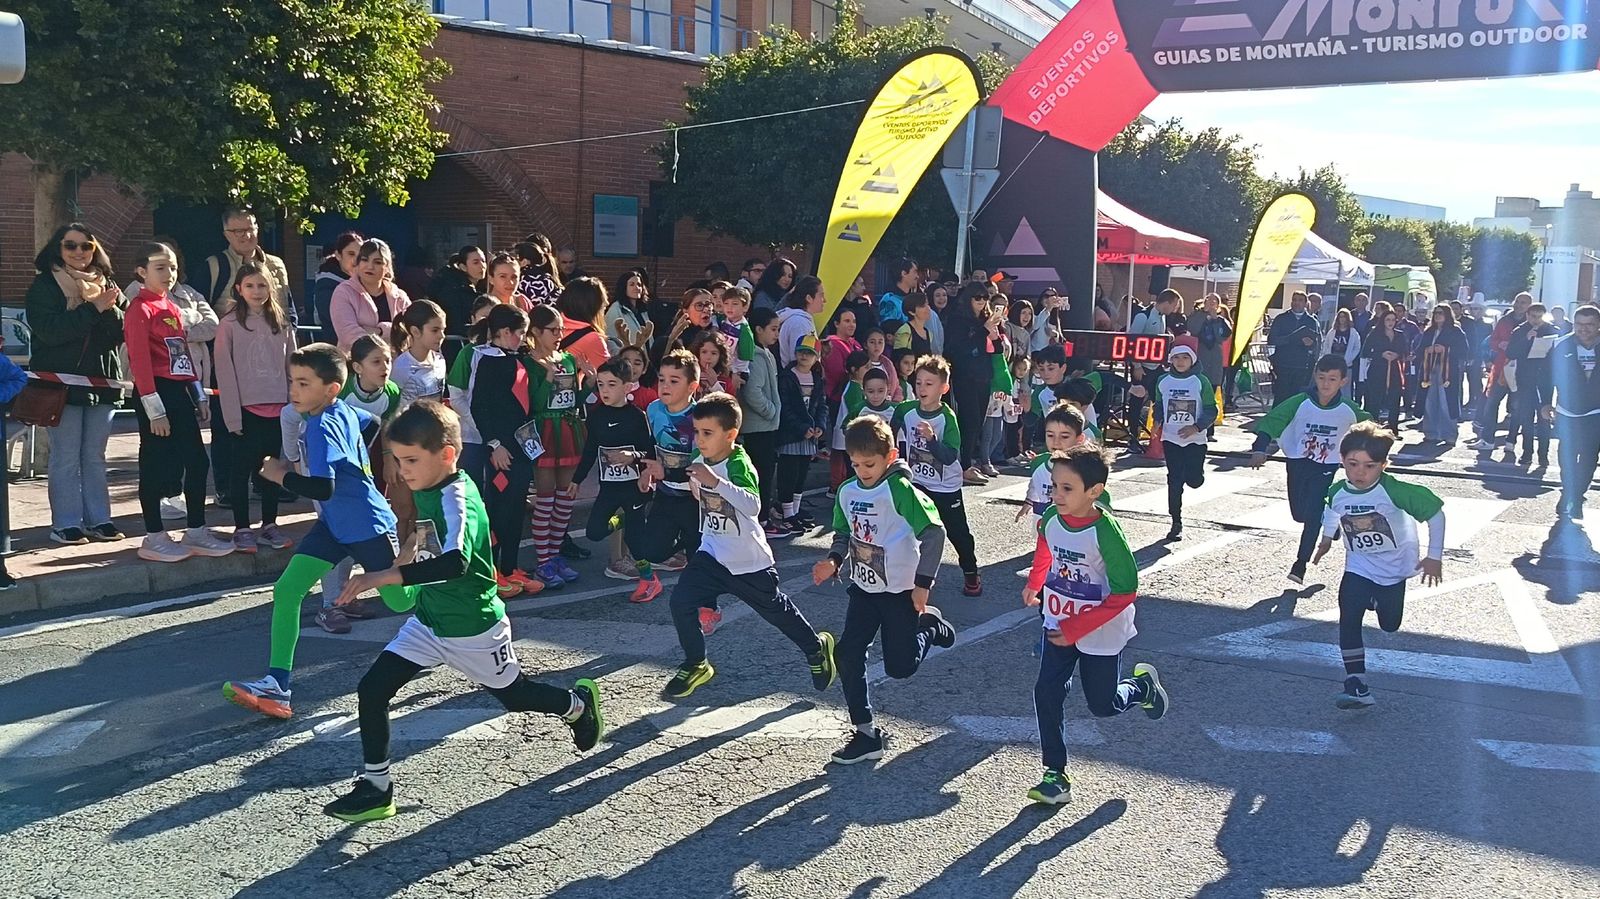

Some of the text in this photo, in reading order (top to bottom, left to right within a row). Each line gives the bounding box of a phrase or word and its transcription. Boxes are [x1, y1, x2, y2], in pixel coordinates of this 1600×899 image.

[1153, 46, 1212, 66] GUIAS
[1216, 45, 1242, 61] DE
[1246, 37, 1347, 60] MONTAÑA
[1362, 32, 1464, 53] TURISMO
[1469, 23, 1588, 47] OUTDOOR
[1028, 29, 1096, 100] EVENTOS
[1028, 30, 1120, 125] DEPORTIVOS
[1112, 336, 1165, 361] 0:00
[557, 392, 574, 404] 333
[1173, 412, 1190, 422] 372
[608, 465, 629, 477] 394
[915, 463, 935, 478] 369
[707, 513, 727, 531] 397
[1354, 533, 1384, 549] 399
